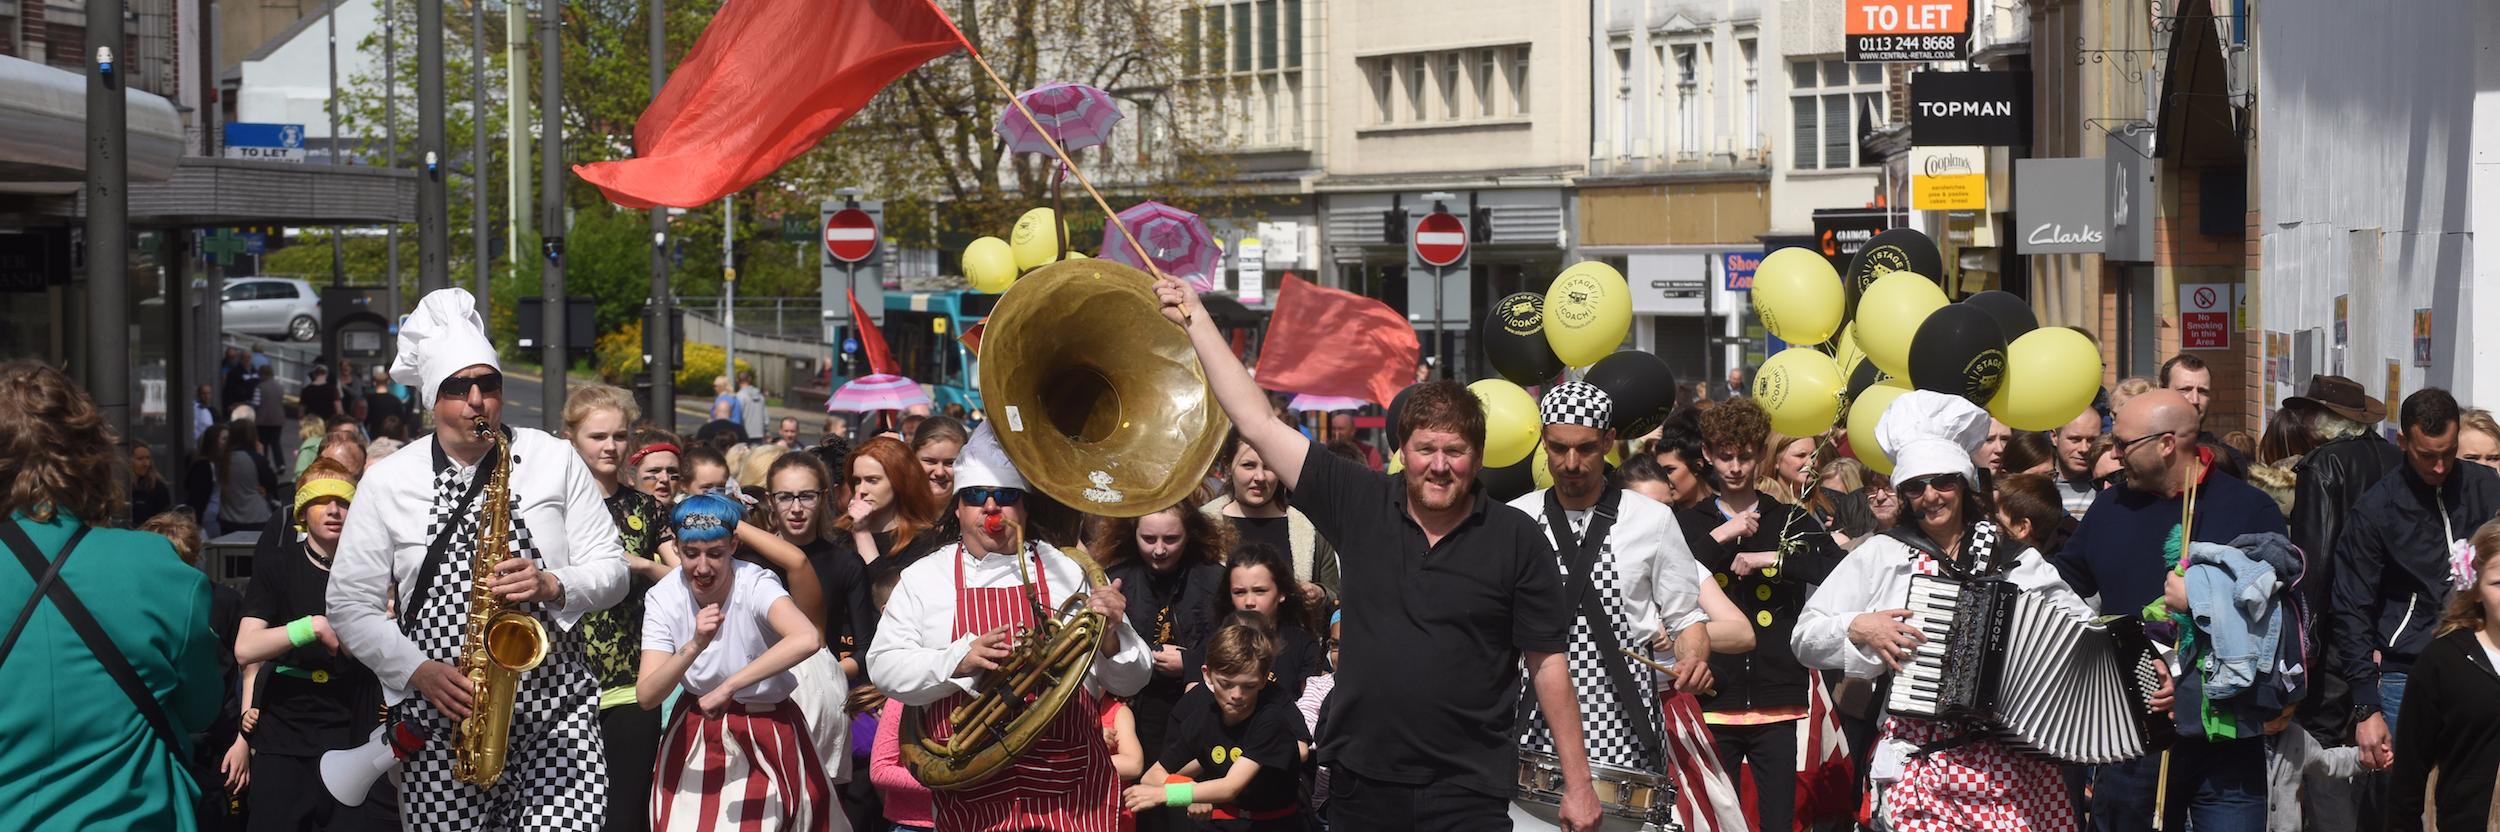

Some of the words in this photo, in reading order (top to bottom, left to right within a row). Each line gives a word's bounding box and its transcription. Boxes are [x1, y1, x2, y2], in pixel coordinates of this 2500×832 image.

[1862, 5, 1898, 30] TO
[1907, 4, 1952, 30] LET
[1860, 37, 1892, 51] 0113
[1895, 37, 1919, 51] 244
[1922, 36, 1955, 51] 8668
[1859, 51, 1955, 60] WWW.CENTRAL-RETAIL.CO.UK
[1918, 101, 2011, 117] TOPMAN
[241, 148, 257, 157] TO
[263, 149, 288, 157] LET
[2028, 222, 2103, 245] Clarks
[1728, 255, 1760, 271] Shoe
[1876, 250, 1904, 269] STAGE
[1567, 279, 1596, 291] STAGE
[1729, 272, 1754, 288] Zon
[1505, 295, 1534, 307] STAGE
[1511, 313, 1542, 328] COACH
[1561, 308, 1589, 321] COACH
[2187, 322, 2223, 331] Smoking
[1976, 358, 2002, 372] STAGE
[1771, 371, 1783, 403] COACH
[1991, 592, 2008, 651] VIGNONI
